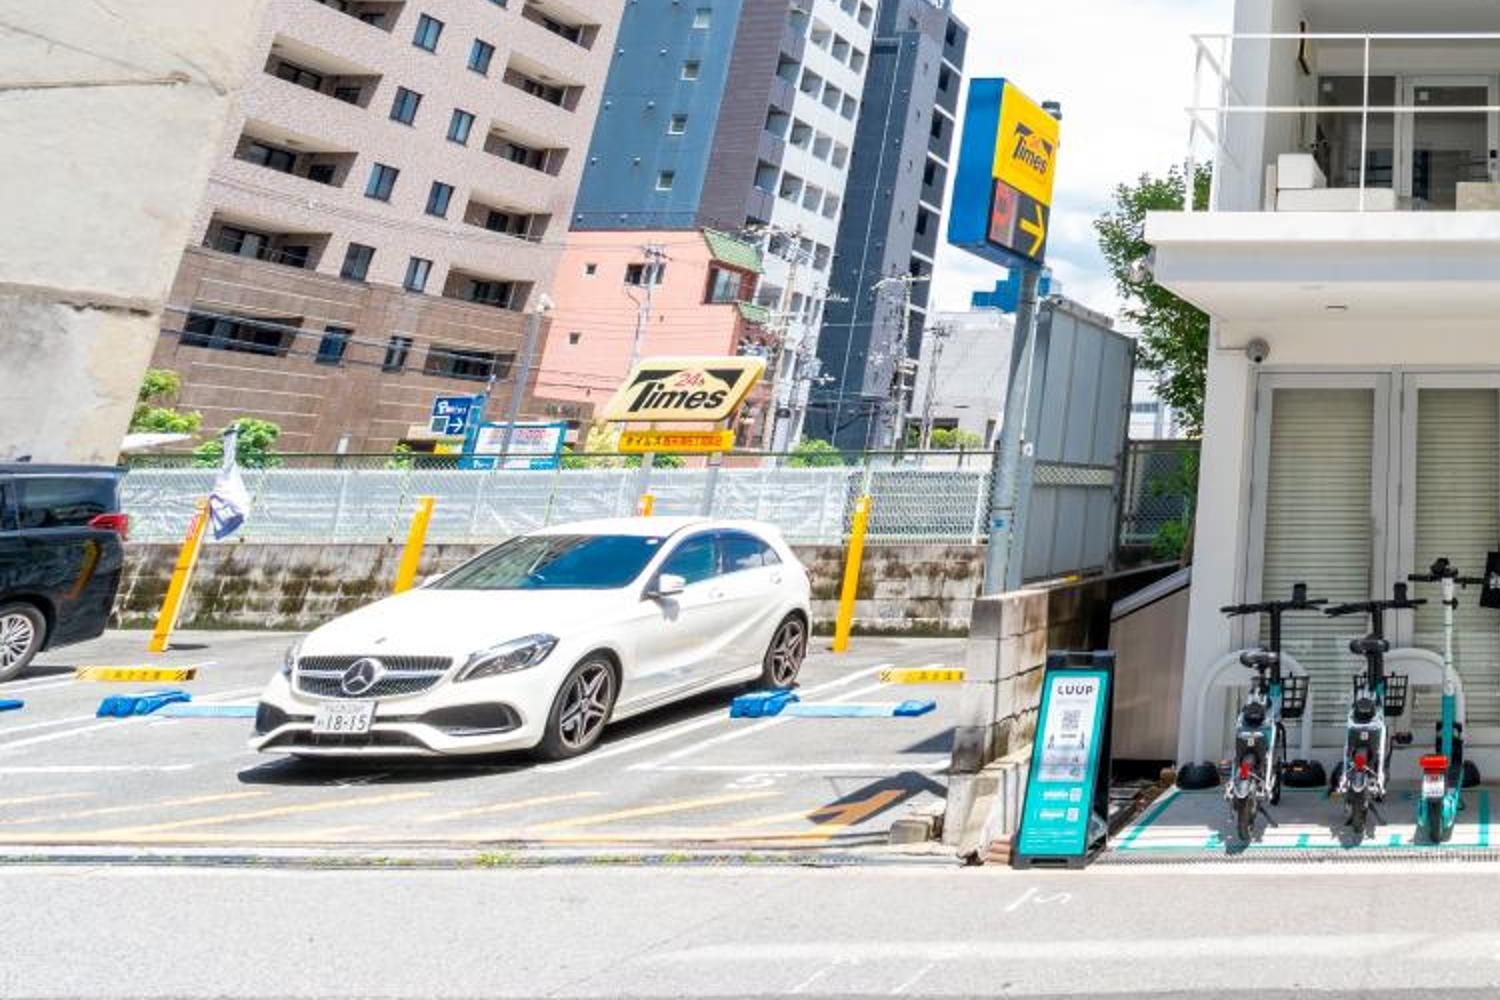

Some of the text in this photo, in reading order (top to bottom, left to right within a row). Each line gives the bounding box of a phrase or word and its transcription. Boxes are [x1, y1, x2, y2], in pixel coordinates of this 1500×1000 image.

[1013, 124, 1048, 175] Times
[627, 371, 728, 413] Times
[1057, 685, 1094, 696] LUUP
[327, 713, 367, 731] 18-15
